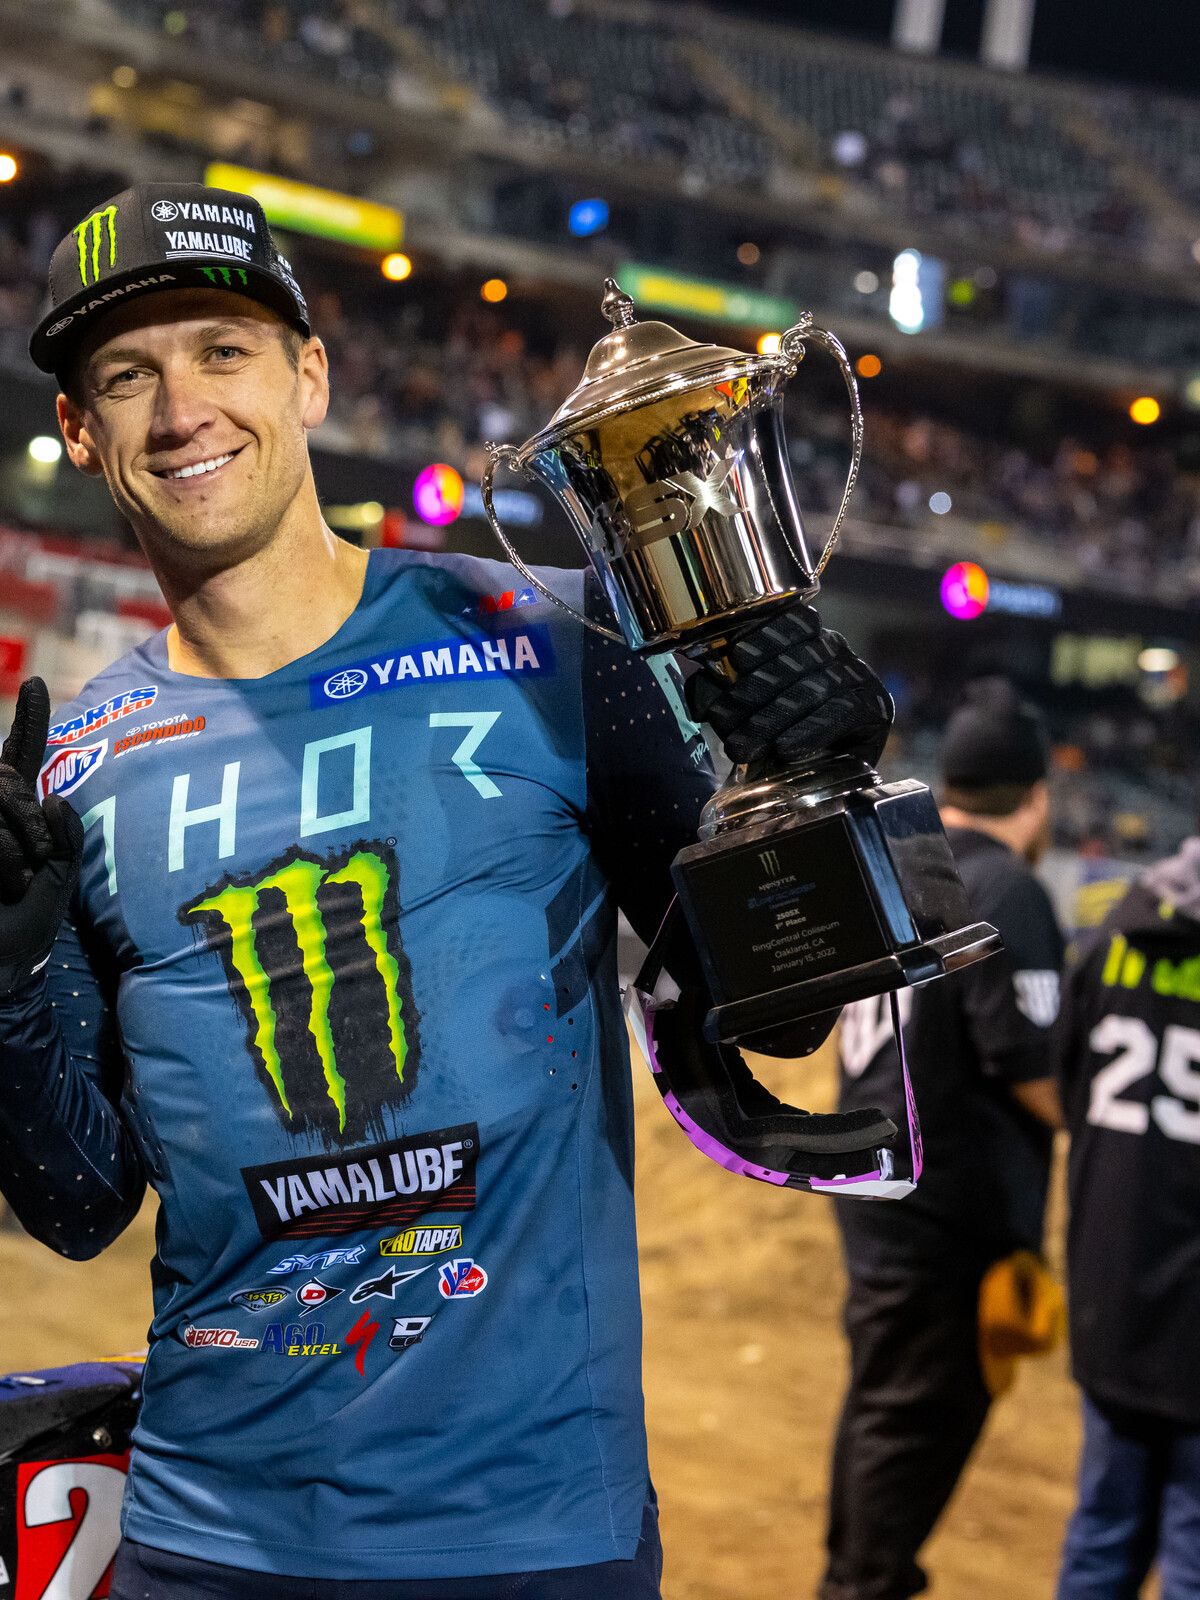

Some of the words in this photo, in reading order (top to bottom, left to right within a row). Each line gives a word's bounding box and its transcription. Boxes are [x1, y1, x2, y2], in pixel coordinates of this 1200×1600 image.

[177, 202, 256, 233] YAMAHA
[165, 231, 251, 261] YAMALUBE
[73, 274, 176, 315] YAMAHA
[372, 635, 540, 685] YAMAHA
[114, 716, 205, 754] ESCONDIDO
[142, 714, 188, 731] TOYOTA
[47, 748, 99, 792] 100%
[752, 933, 800, 952] RingCentral
[801, 921, 840, 937] Coliseum
[812, 938, 825, 947] CA
[771, 957, 804, 972] January
[817, 947, 837, 959] 2022
[260, 1141, 463, 1223] YAMALUBE
[383, 1229, 460, 1253] PROTAPER
[195, 1328, 237, 1346] BOXO
[234, 1338, 258, 1347] USA
[259, 1322, 326, 1354] A60
[288, 1343, 342, 1356] EXCEL
